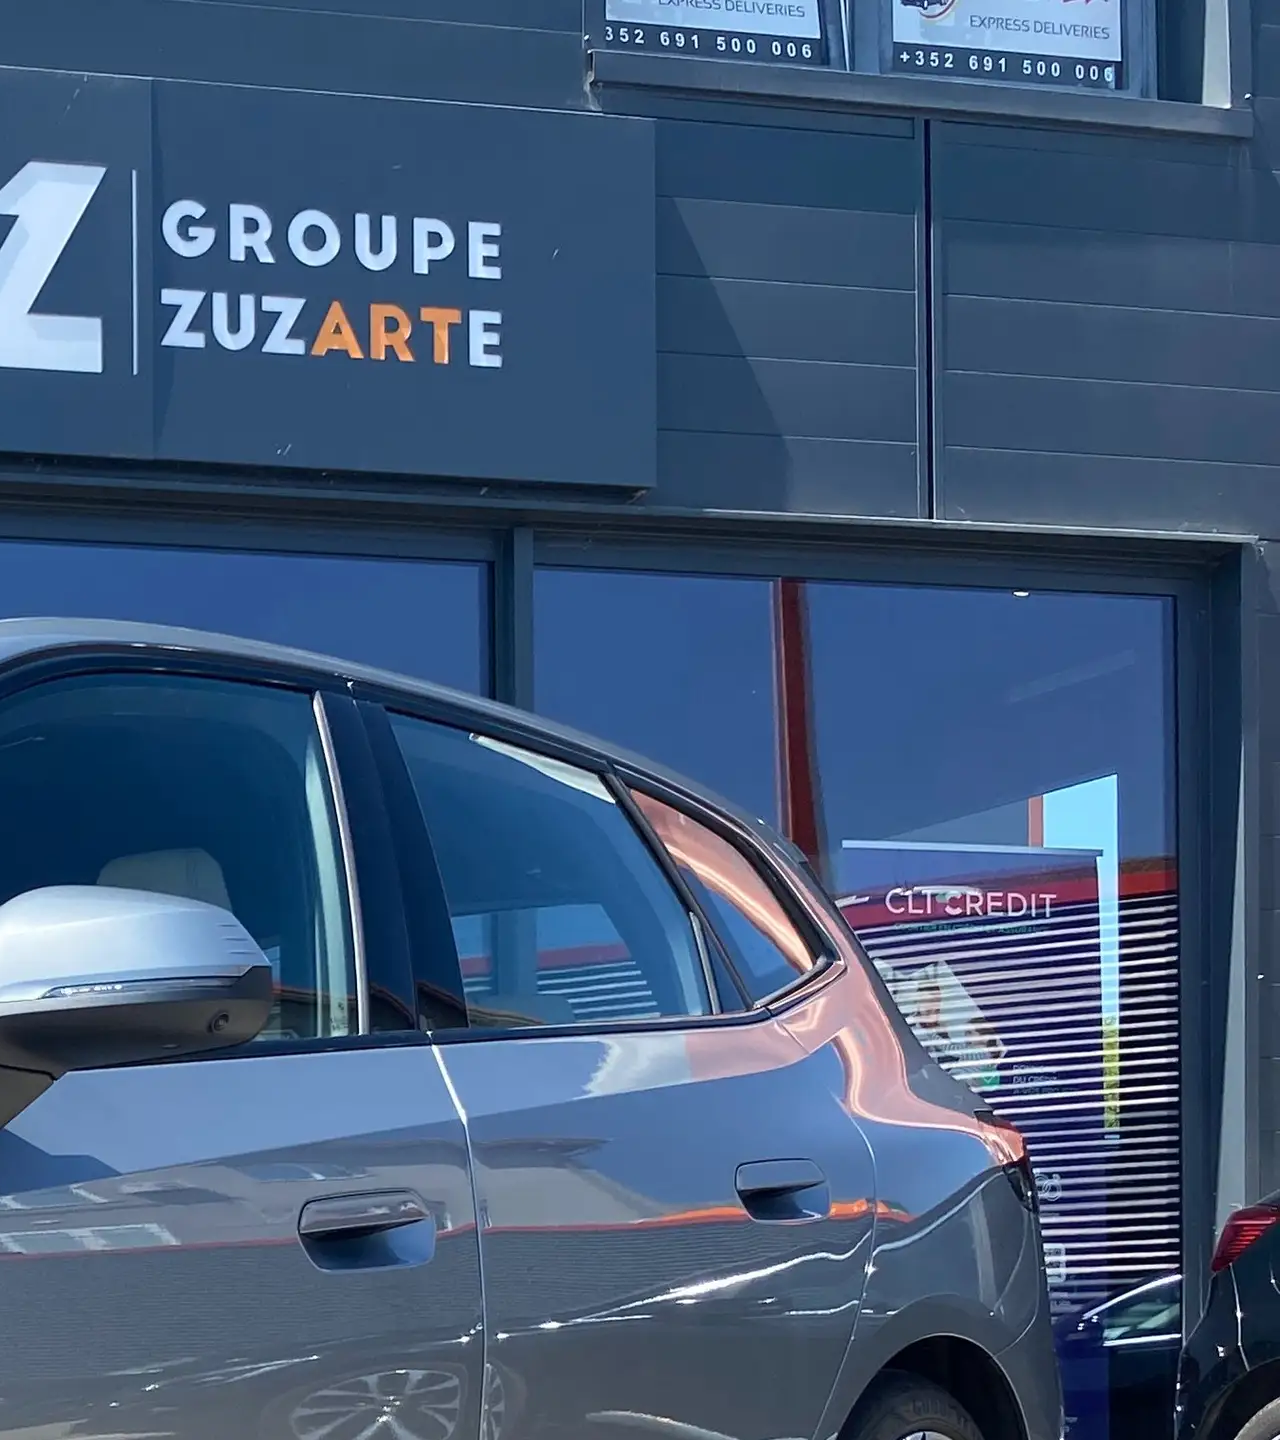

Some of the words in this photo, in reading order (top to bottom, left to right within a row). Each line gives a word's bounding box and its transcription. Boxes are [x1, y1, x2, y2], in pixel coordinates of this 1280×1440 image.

[725, 0, 805, 17] DELIVERIES
[969, 14, 1030, 32] EXPRESS
[1033, 21, 1110, 39] DELIVERIES
[659, 31, 700, 49] 691
[716, 36, 756, 54] 500
[771, 41, 812, 58] 006
[899, 50, 954, 68] +352
[969, 55, 1007, 72] 691
[1022, 60, 1061, 77] 500
[1075, 65, 1114, 82] 006
[161, 199, 502, 280] GROUPE
[160, 288, 503, 368] ZUZARTE
[885, 887, 932, 914] CLT
